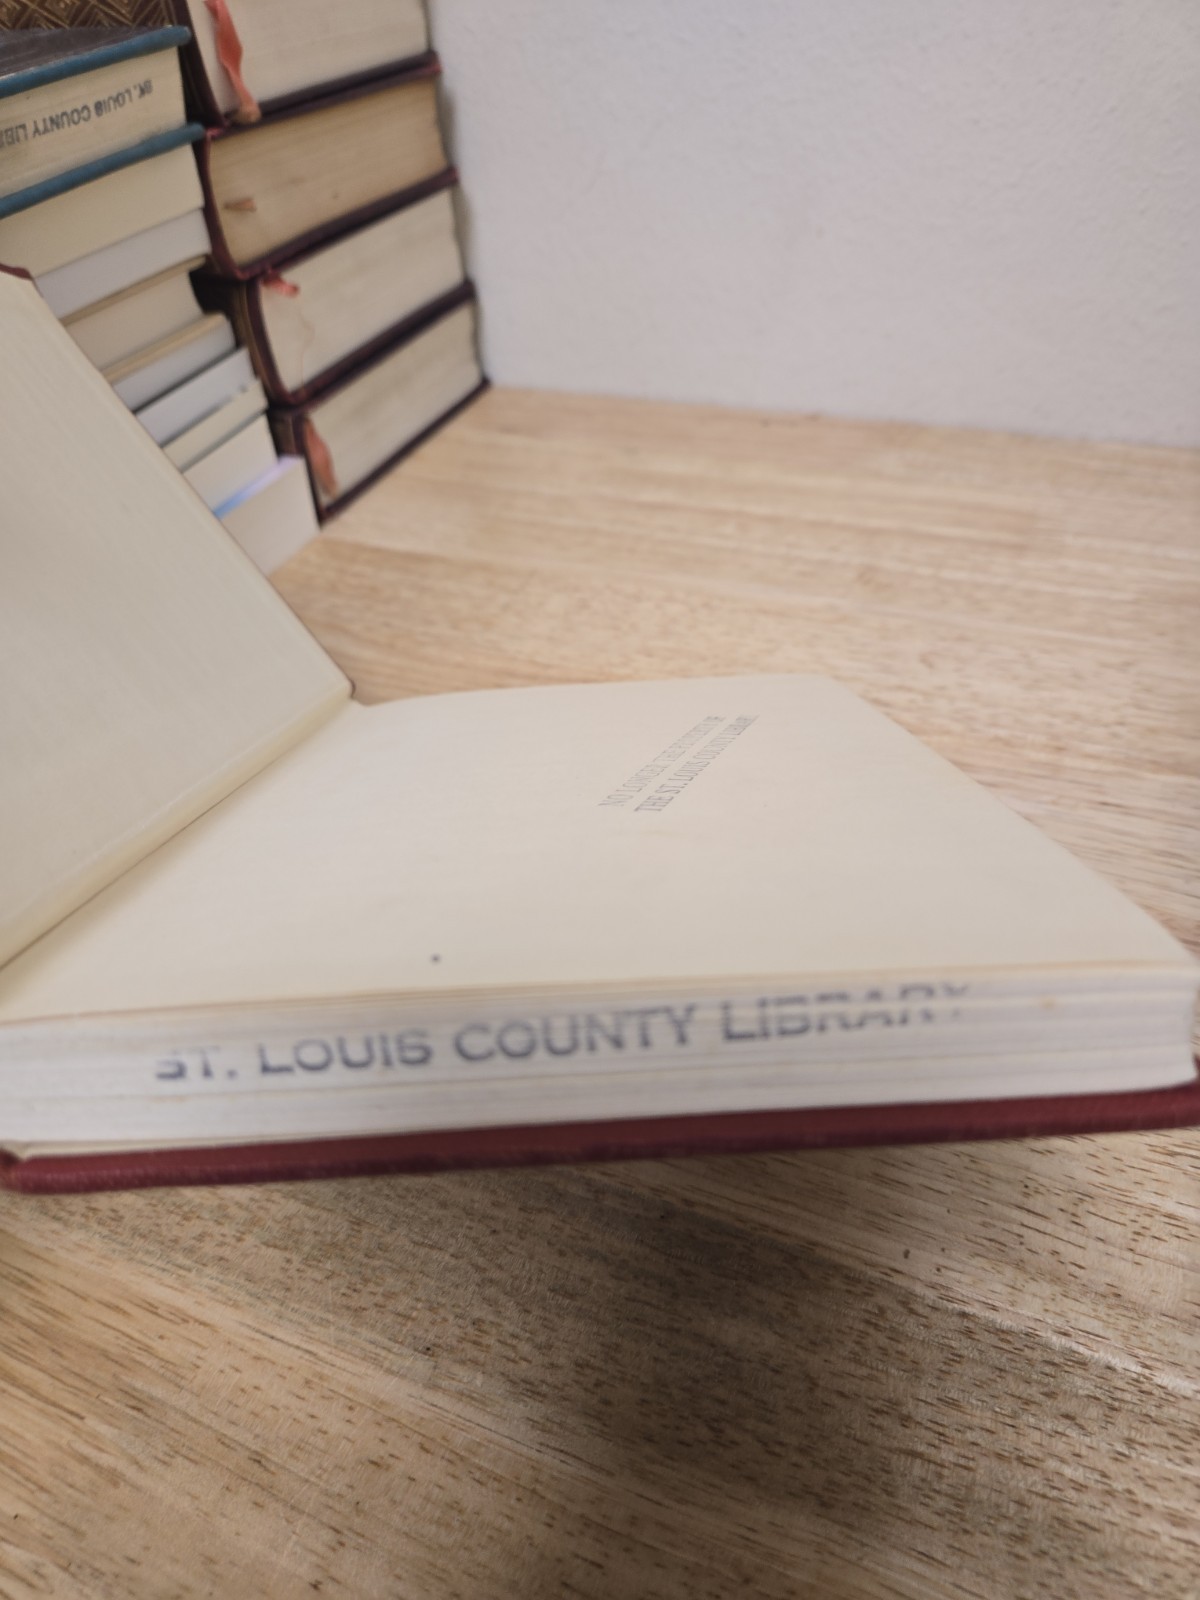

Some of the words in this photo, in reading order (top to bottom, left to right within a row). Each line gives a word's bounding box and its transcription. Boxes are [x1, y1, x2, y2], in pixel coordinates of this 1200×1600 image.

[32, 104, 92, 138] COUNTY
[94, 88, 133, 118] LOUIS
[633, 794, 675, 812] THE
[667, 760, 712, 782] LOUIS
[258, 1029, 434, 1075] LOUIS
[453, 1003, 696, 1062] COUNTY
